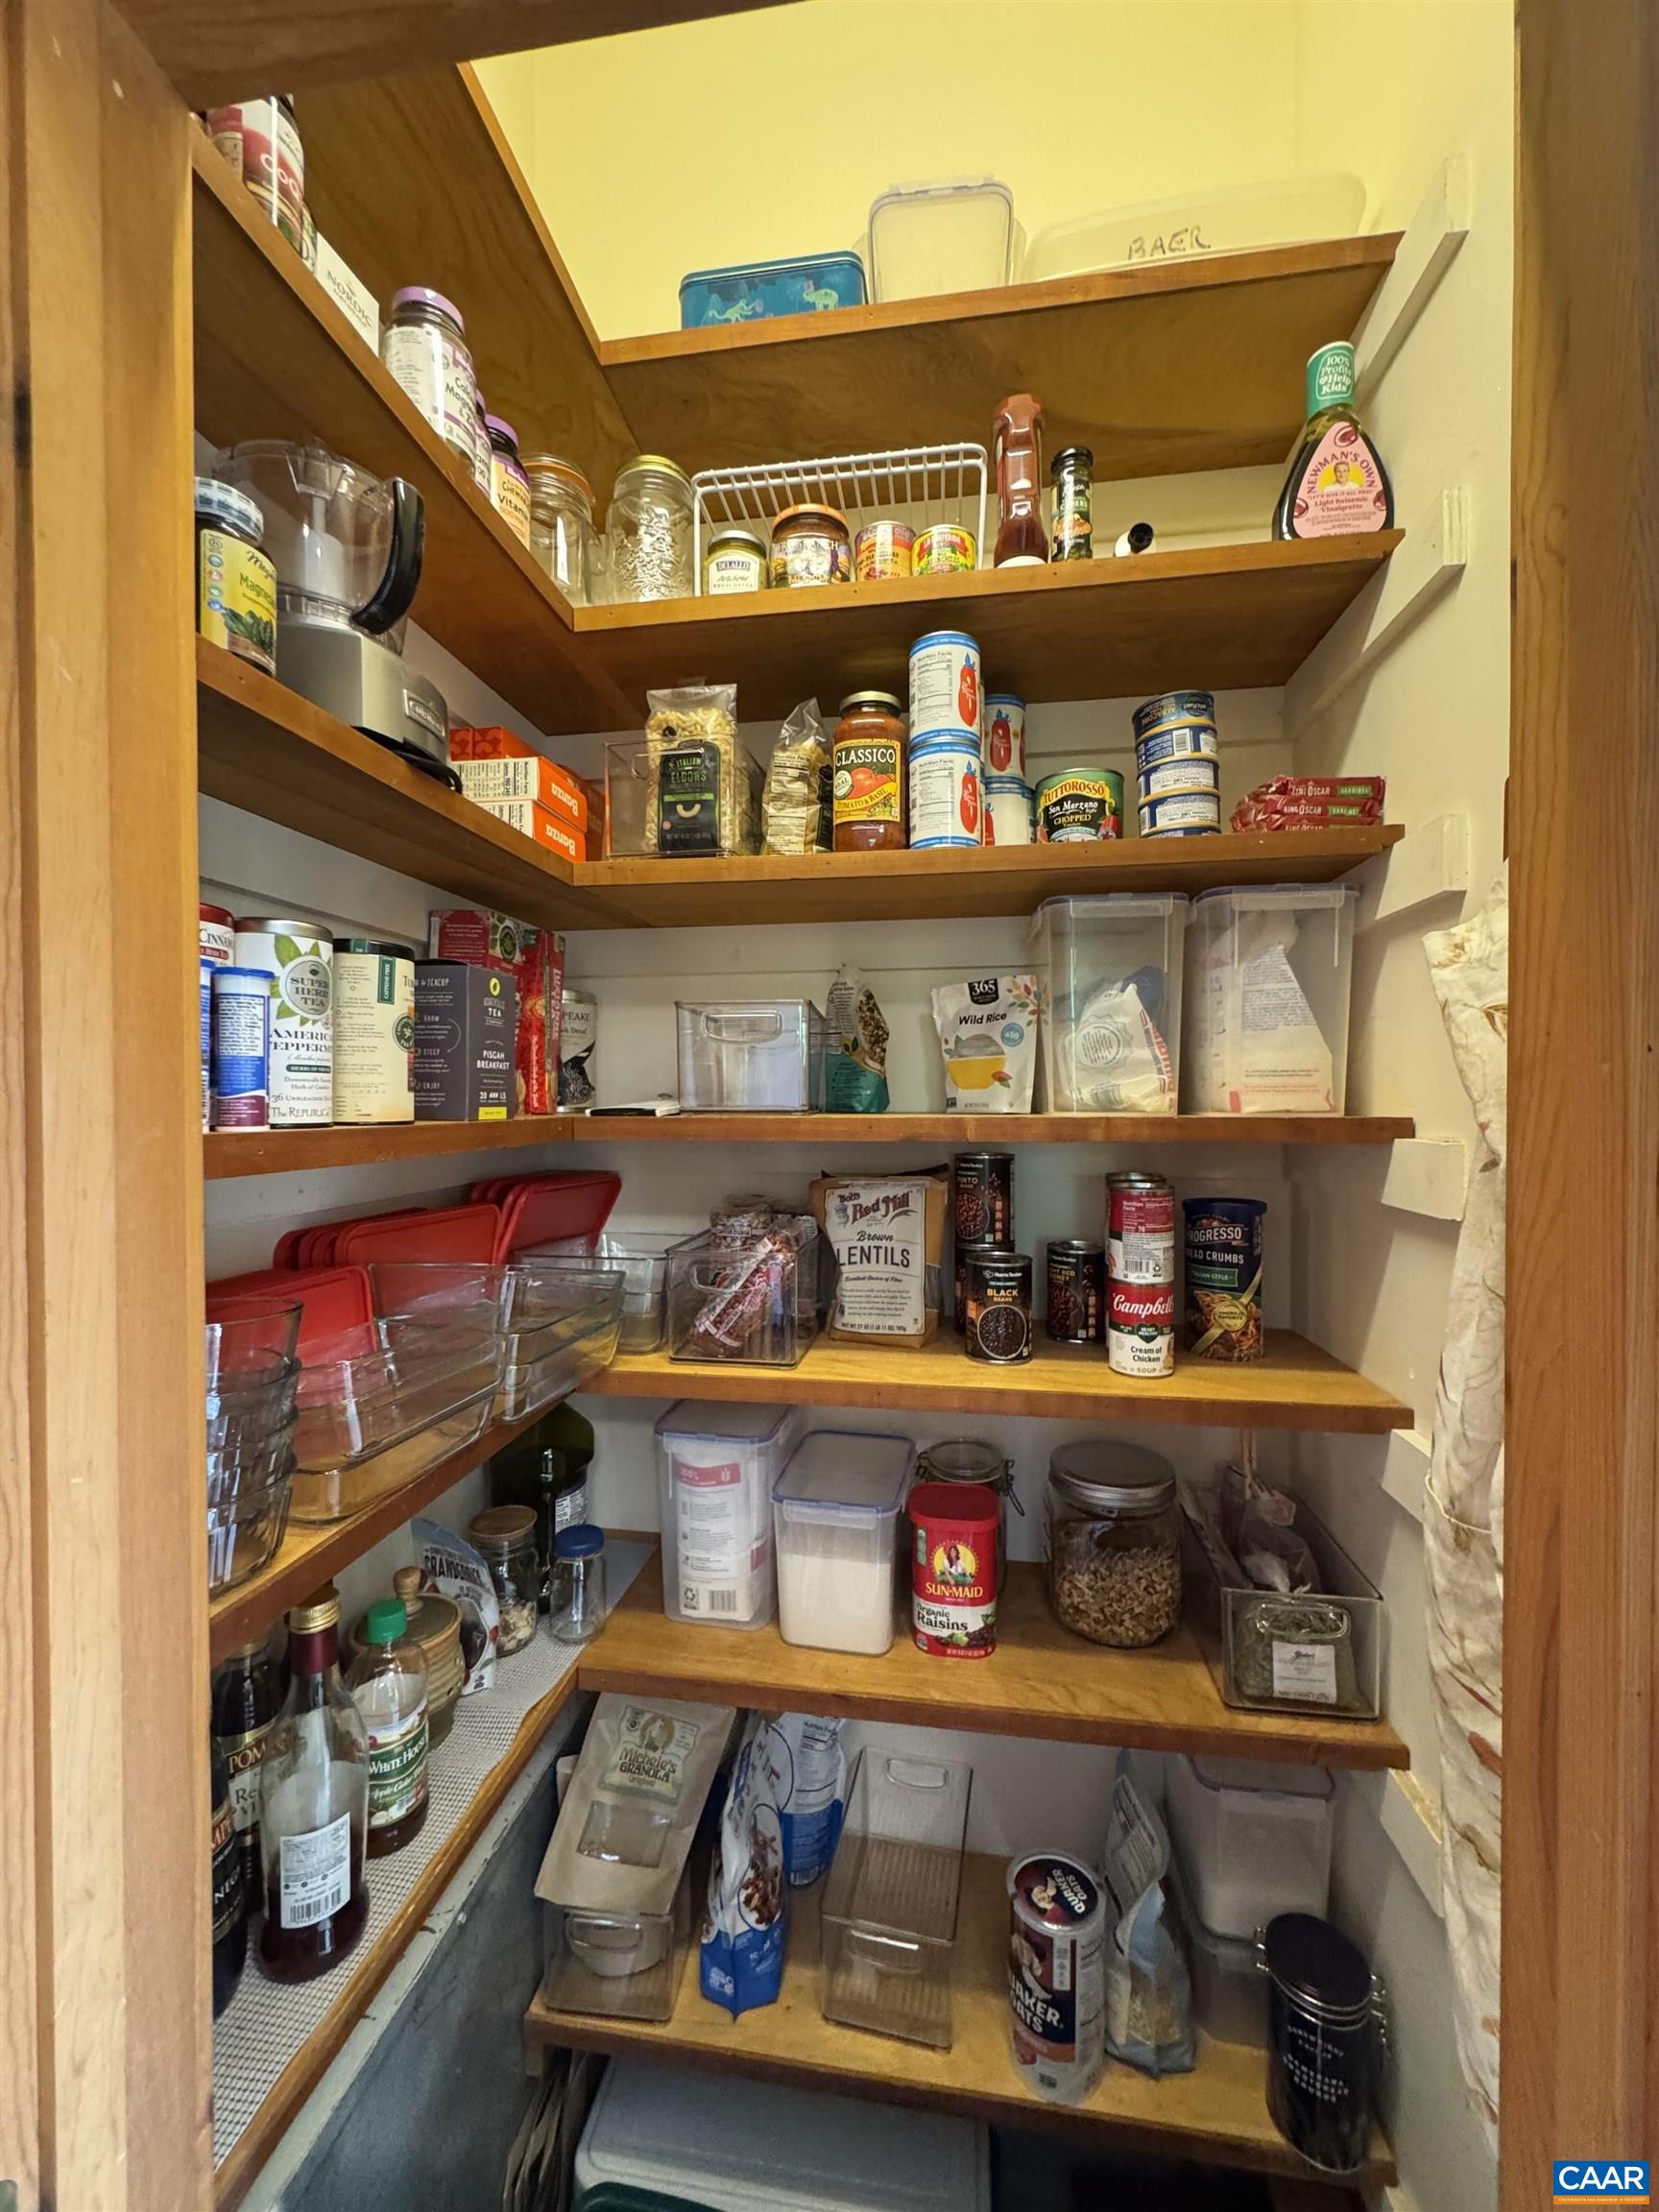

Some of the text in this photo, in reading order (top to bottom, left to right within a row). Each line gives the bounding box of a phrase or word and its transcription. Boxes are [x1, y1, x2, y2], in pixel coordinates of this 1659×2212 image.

[1127, 224, 1212, 261] BAER
[326, 269, 373, 328] NORDIC
[1327, 355, 1350, 367] 100%
[1321, 365, 1352, 376] Profits
[1328, 373, 1352, 386] Help
[1320, 382, 1348, 396] Kids
[1307, 451, 1379, 494] NEWMAN'S OWN
[1314, 495, 1368, 508] Light Balsamic
[1321, 503, 1363, 514] Vinaigrette
[676, 757, 703, 768] ITALIAN
[835, 748, 896, 767] CLASSICO
[670, 771, 707, 783] ELBOWS
[1044, 781, 1105, 805] TUTTOROSSO
[1307, 785, 1331, 796] OSCAR
[551, 782, 579, 817] Banza
[836, 799, 864, 810] TOMATO
[869, 787, 889, 803] BASIL
[1048, 800, 1098, 814] San Marzano
[1299, 805, 1322, 815] OSCAR
[1053, 813, 1092, 826] CHOPPED
[545, 823, 576, 856] Banza
[290, 977, 329, 990] SUPER
[972, 979, 996, 996] 365
[295, 987, 329, 998] HERB
[301, 997, 325, 1007] TEA
[488, 1007, 502, 1018] TEA
[959, 1012, 1008, 1025] Wild Rice
[476, 1059, 510, 1070] BREAKFAST
[271, 1093, 284, 1103] 36
[272, 1106, 288, 1118] The
[851, 1190, 910, 1225] Red Mill
[856, 1230, 894, 1242] Brown
[836, 1244, 910, 1268] LENTILS
[1206, 1251, 1244, 1264] CRUMBS
[986, 1288, 1019, 1297] BLACK
[1133, 1354, 1161, 1362] Chicken
[916, 1602, 950, 1618] Organic
[917, 1611, 969, 1631] Raisins
[369, 1756, 402, 1774] WHITE
[618, 1747, 678, 1775] Michele's
[619, 1762, 670, 1783] GRANOLA
[1052, 1867, 1086, 1914] QUAKER
[1066, 1873, 1088, 1901] OATS
